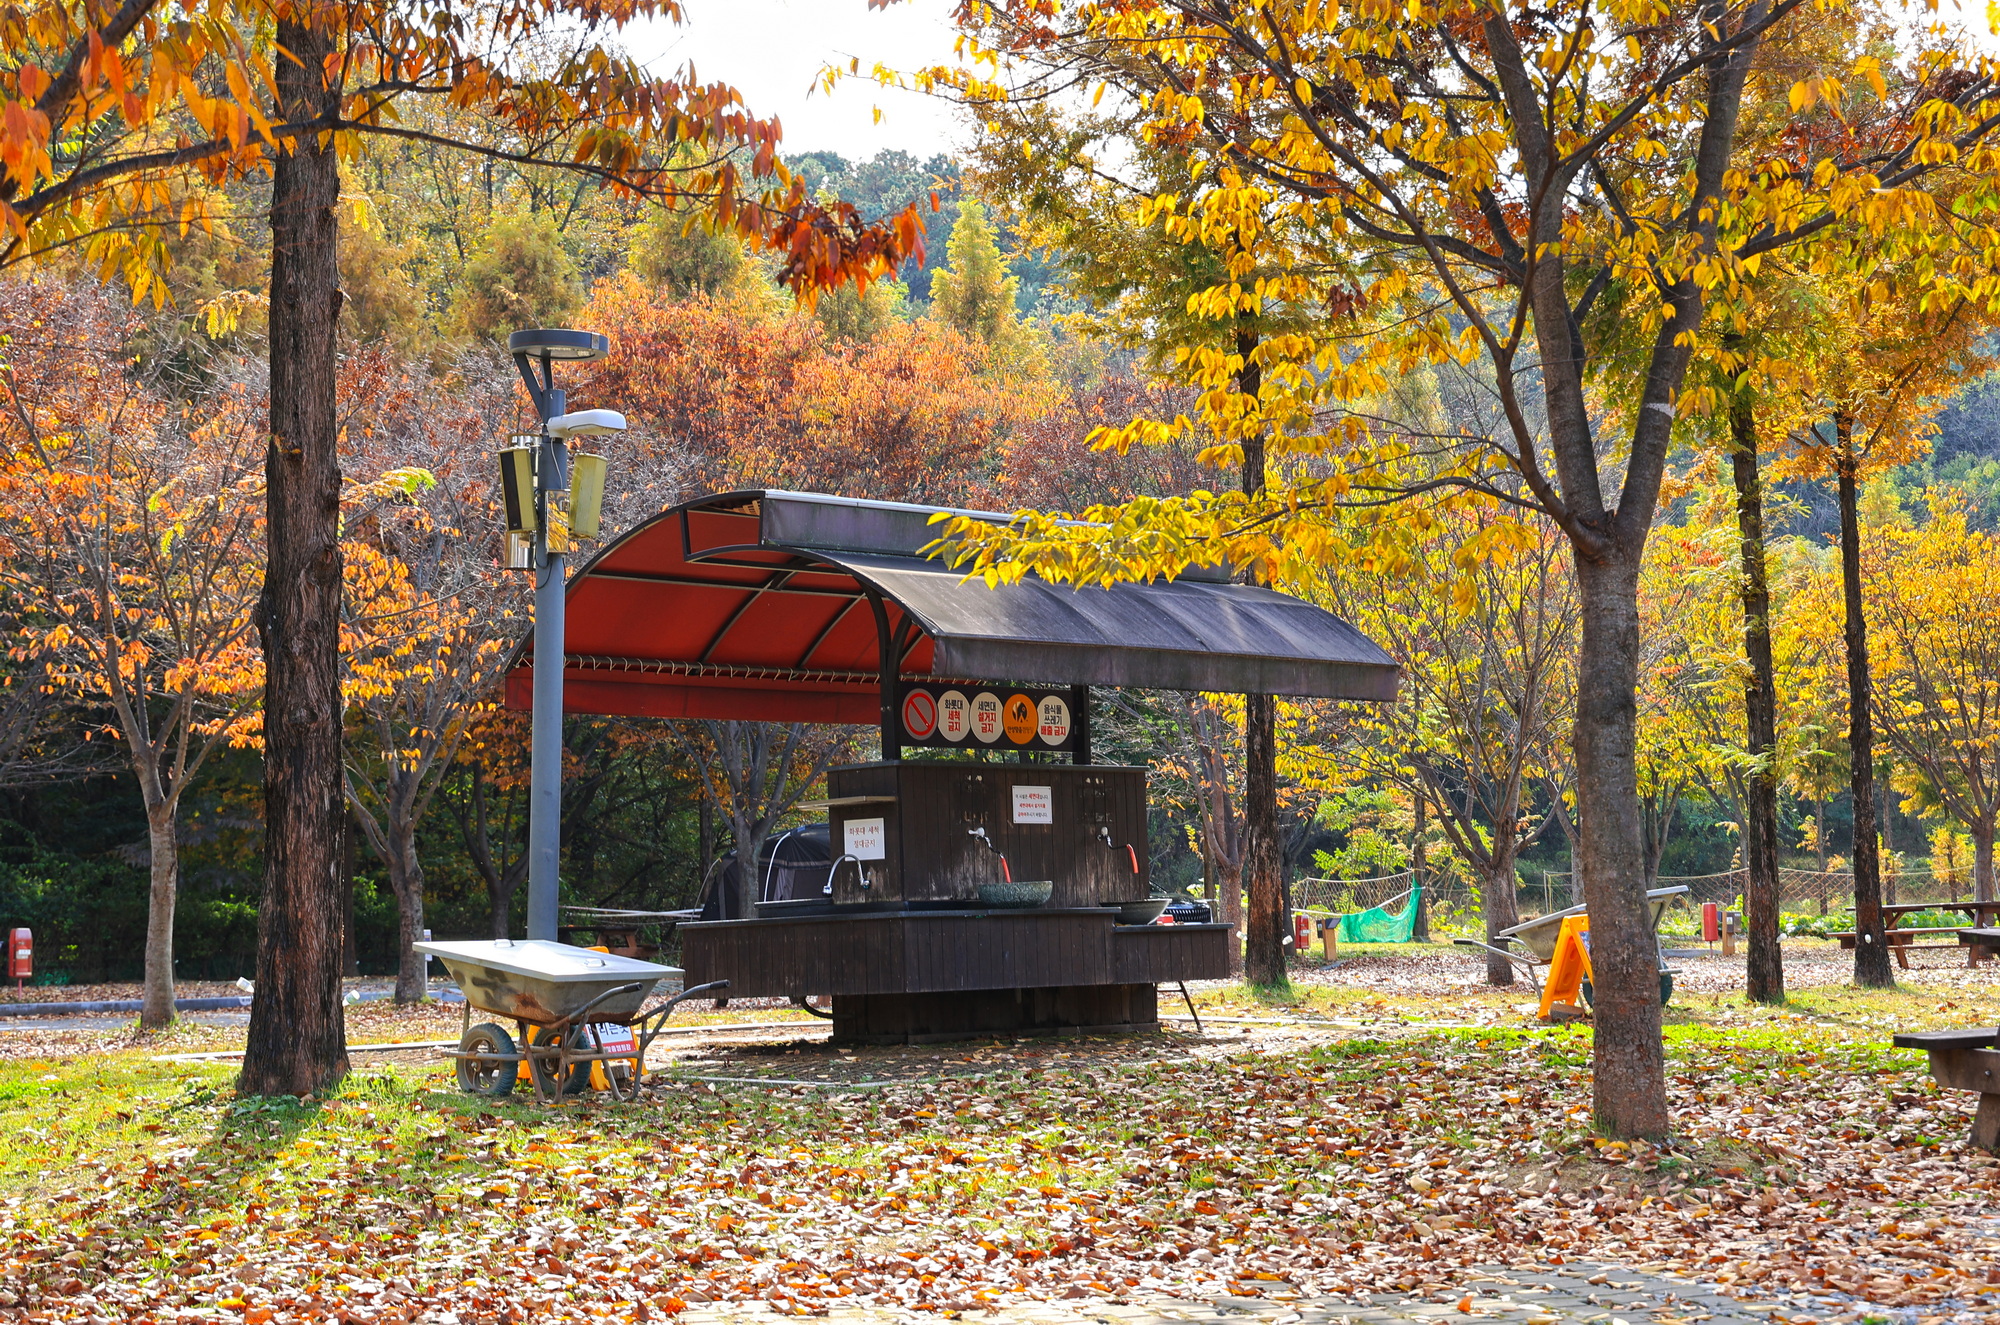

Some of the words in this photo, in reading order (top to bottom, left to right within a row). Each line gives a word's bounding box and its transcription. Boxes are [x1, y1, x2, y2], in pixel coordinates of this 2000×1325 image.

[978, 701, 996, 711] 세면대
[1044, 704, 1062, 715] 음식물
[948, 710, 960, 721] 세척
[978, 712, 997, 722] 설거지
[1044, 715, 1063, 725] 쓰레기
[948, 721, 961, 732] 금지
[981, 723, 994, 733] 금지
[1040, 725, 1053, 736] 배출
[1054, 726, 1067, 736] 금지
[868, 825, 880, 834] 세척
[854, 839, 876, 848] 절대금지
